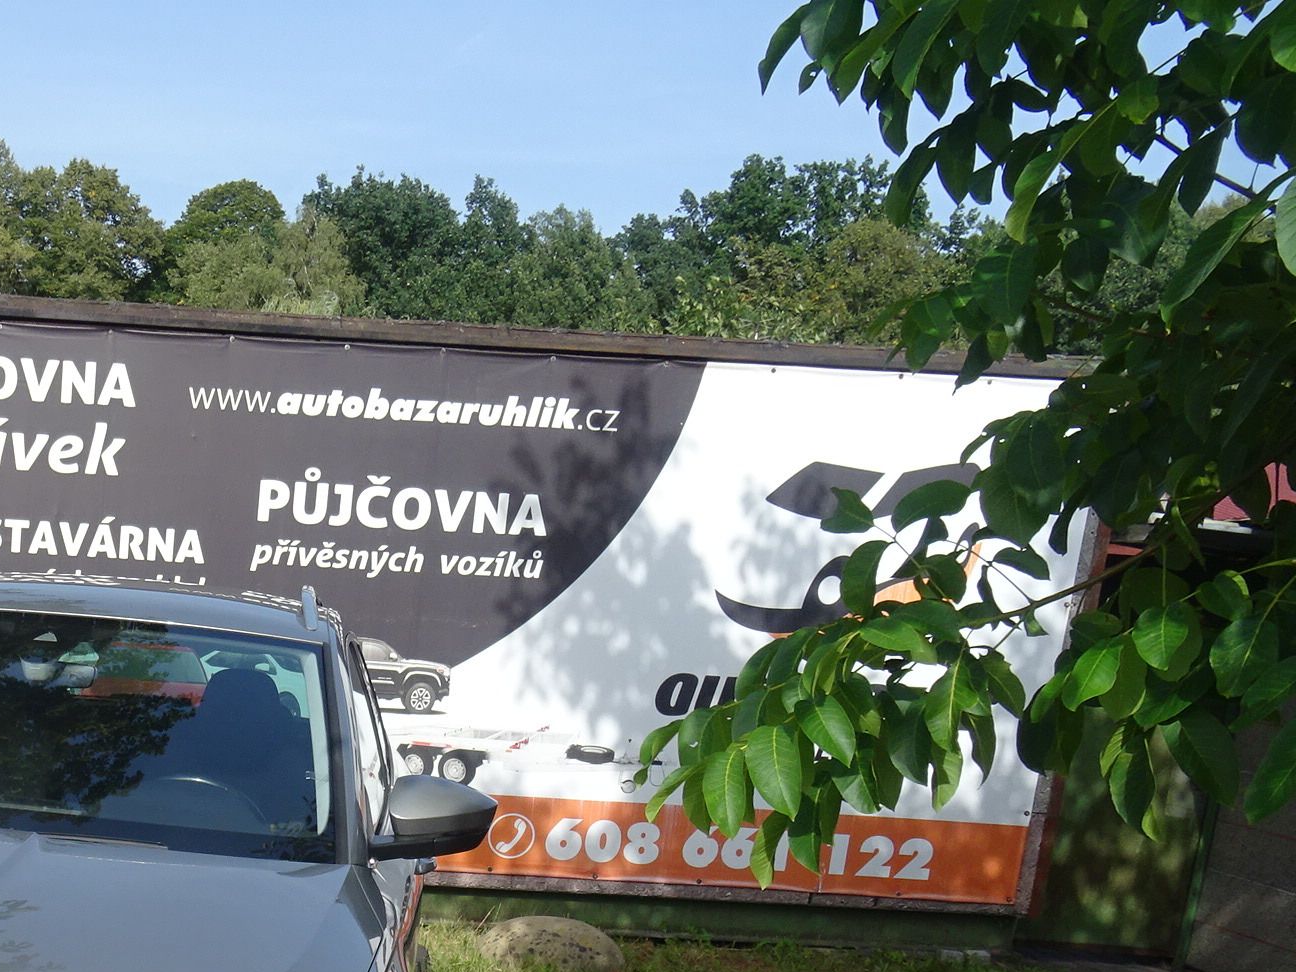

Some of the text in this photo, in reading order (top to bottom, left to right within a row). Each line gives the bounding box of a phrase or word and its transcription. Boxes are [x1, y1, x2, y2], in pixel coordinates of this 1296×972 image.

[189, 386, 621, 433] www.autobazaruhlik.cz
[257, 467, 547, 537] PŮJČOVNA
[249, 540, 544, 580] přívěsných vozíků
[545, 817, 660, 865] 608
[827, 832, 935, 881] 122
